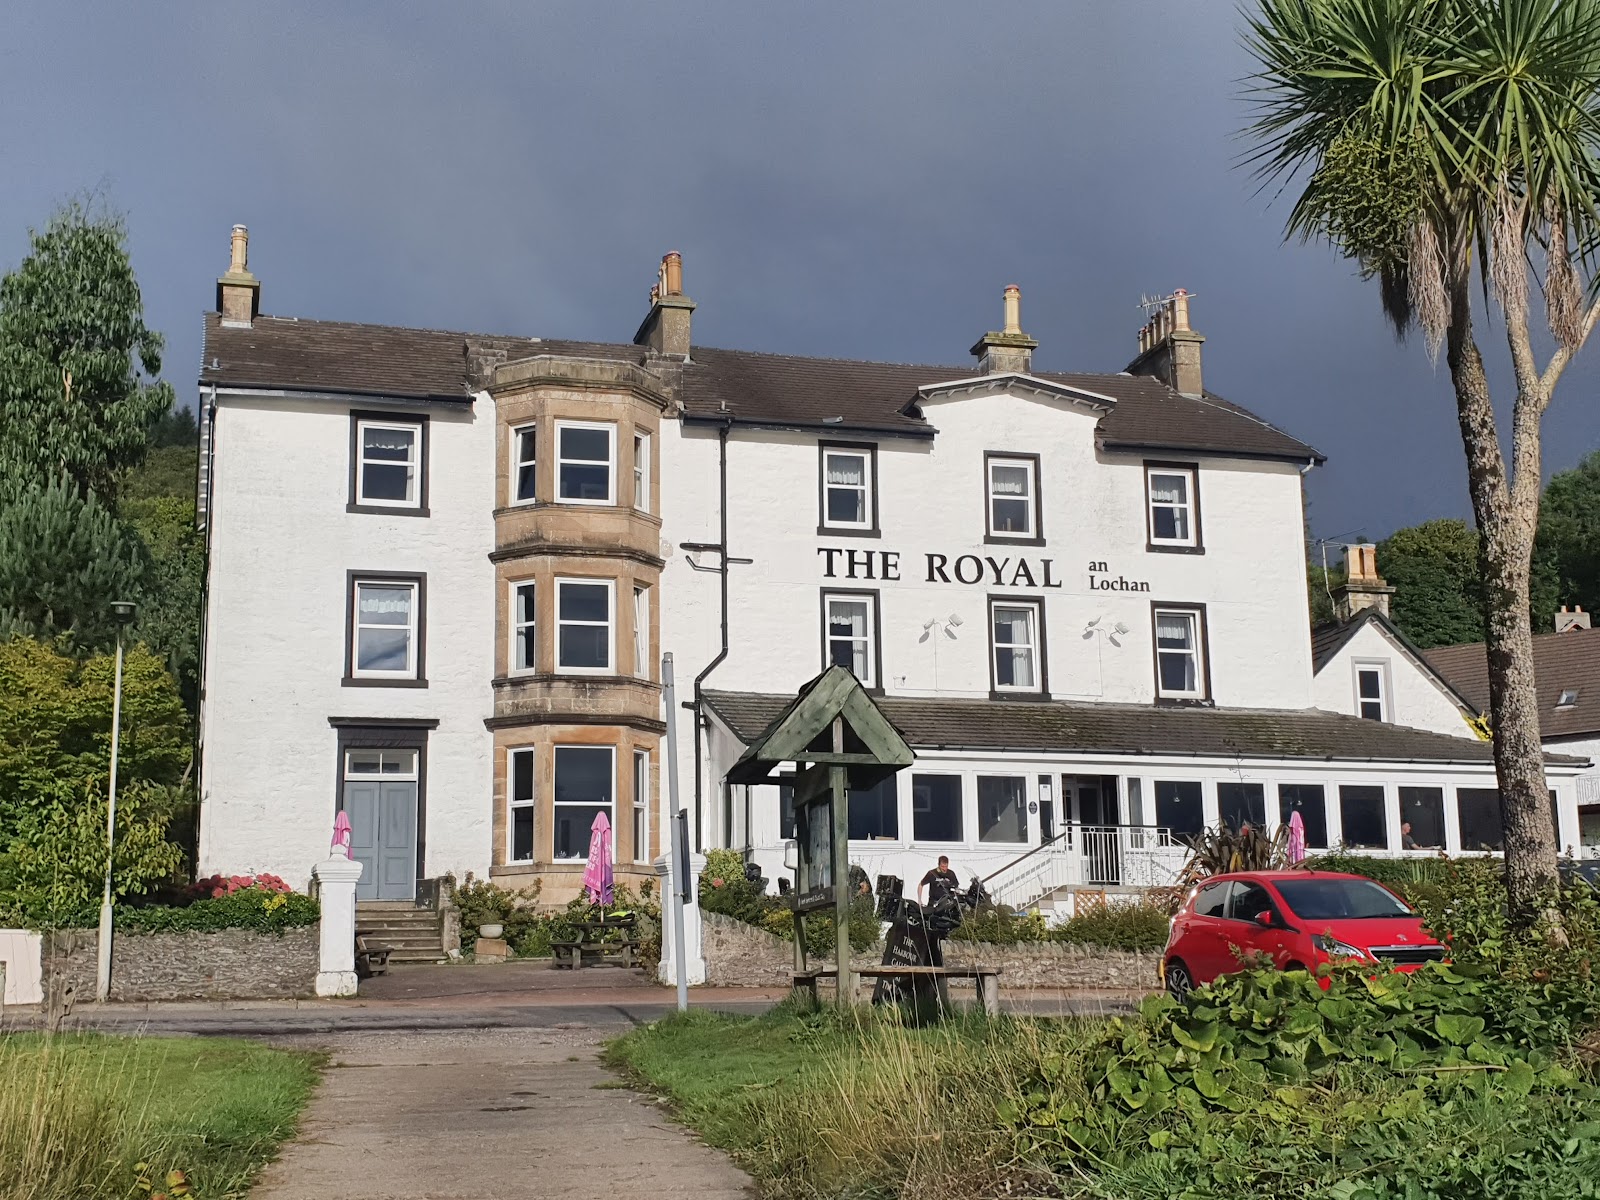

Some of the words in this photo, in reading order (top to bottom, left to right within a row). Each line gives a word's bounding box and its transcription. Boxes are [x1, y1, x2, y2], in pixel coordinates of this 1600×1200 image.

[817, 548, 901, 581] THE
[924, 553, 1062, 588] ROYAL
[1088, 561, 1109, 572] an
[1089, 575, 1150, 592] Lochan
[903, 936, 914, 948] THE
